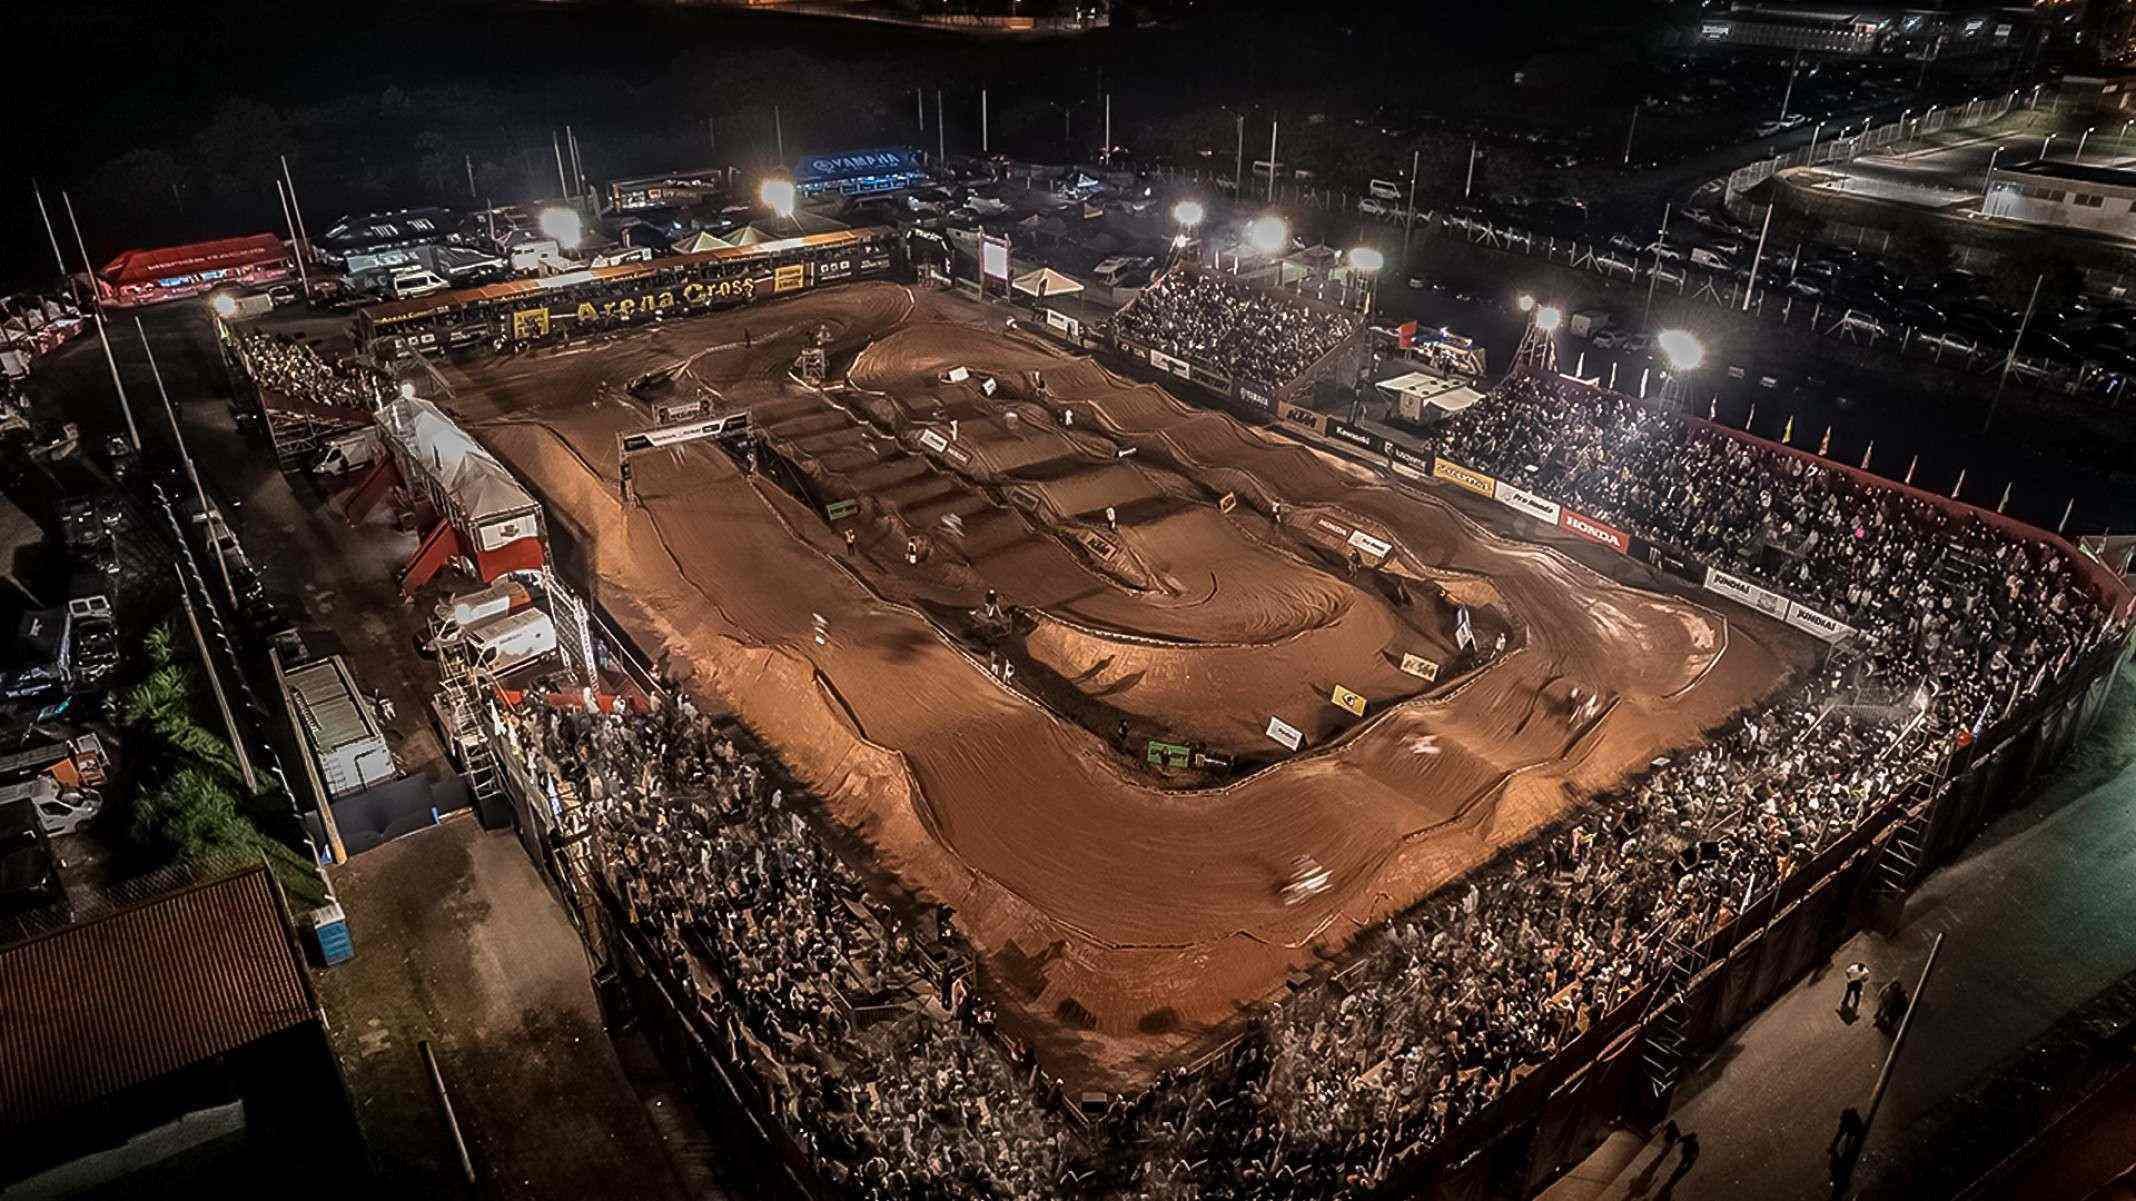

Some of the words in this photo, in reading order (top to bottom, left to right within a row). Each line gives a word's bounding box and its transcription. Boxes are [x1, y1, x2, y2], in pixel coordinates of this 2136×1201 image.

[577, 291, 674, 321] Arena
[683, 276, 755, 306] Cross
[1566, 515, 1622, 548] HONDA
